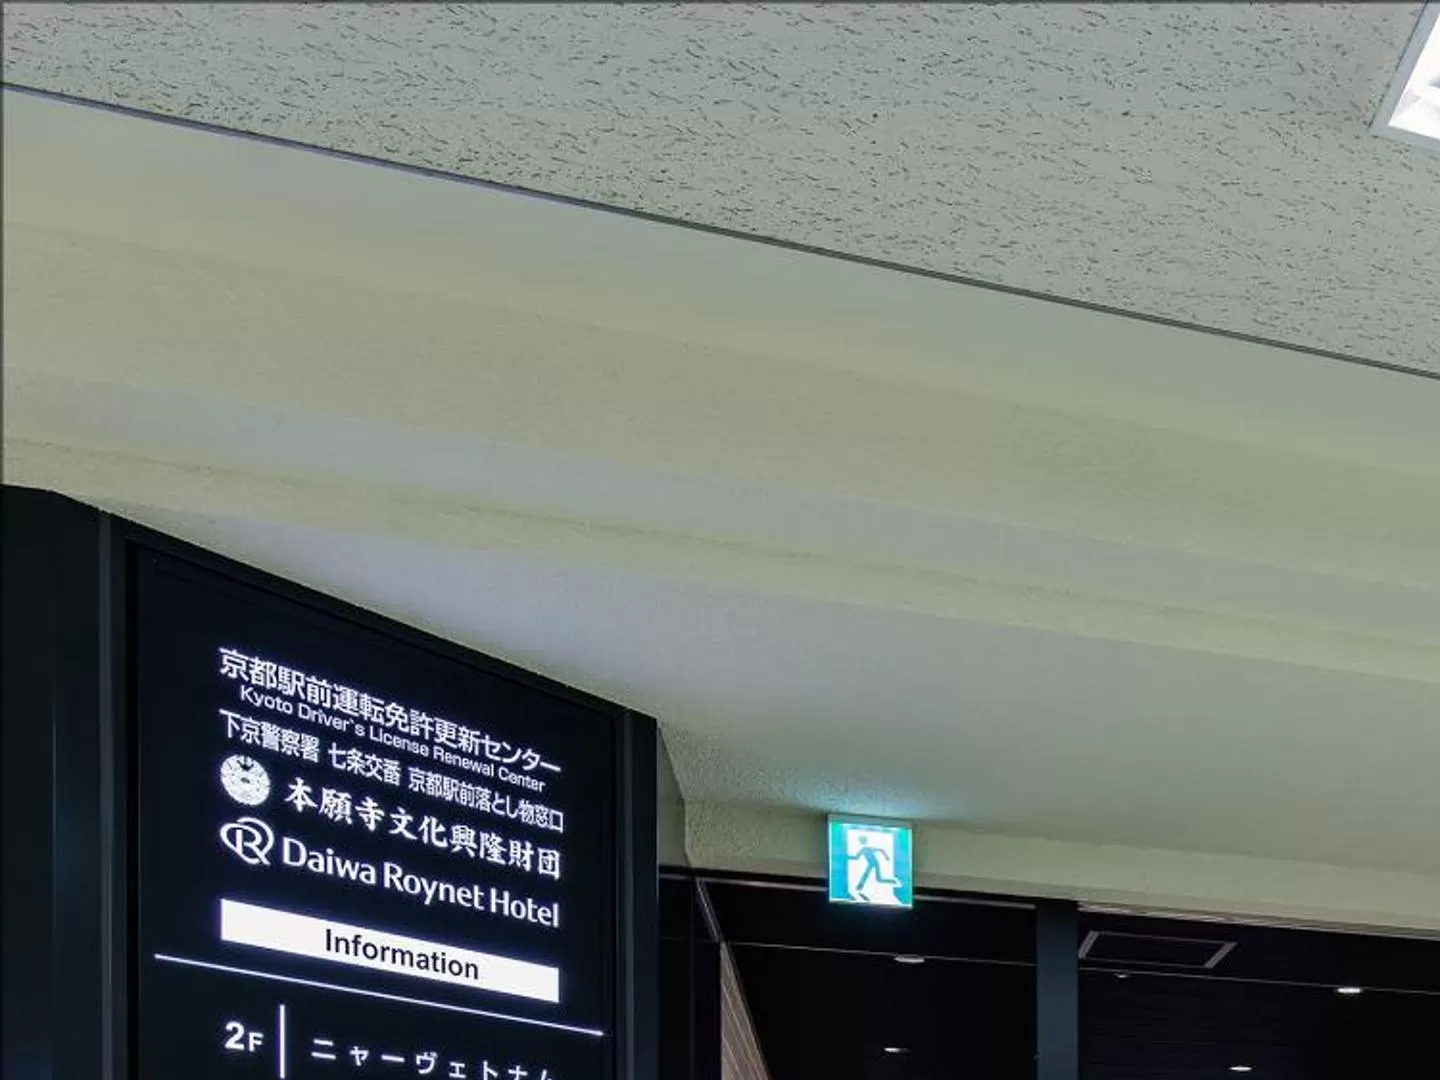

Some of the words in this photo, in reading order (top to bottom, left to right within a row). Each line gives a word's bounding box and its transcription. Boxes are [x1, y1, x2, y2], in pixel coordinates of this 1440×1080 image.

[219, 647, 562, 773] 京都駅前運転免許更新センター
[240, 685, 293, 716] Kyoto
[370, 724, 429, 757] License
[433, 744, 495, 777] Renewal
[499, 766, 546, 793] Center
[219, 708, 319, 764] 下京警察署
[328, 743, 401, 785] 七条交番
[408, 768, 564, 833] 京都駅前落とし物窓口
[285, 777, 561, 880] 本願寺文化興隆財団
[282, 836, 376, 885] Daiwa
[383, 861, 485, 911] Roynet
[490, 888, 560, 928] Hotel
[325, 928, 480, 981] Information
[224, 1021, 264, 1053] 2F
